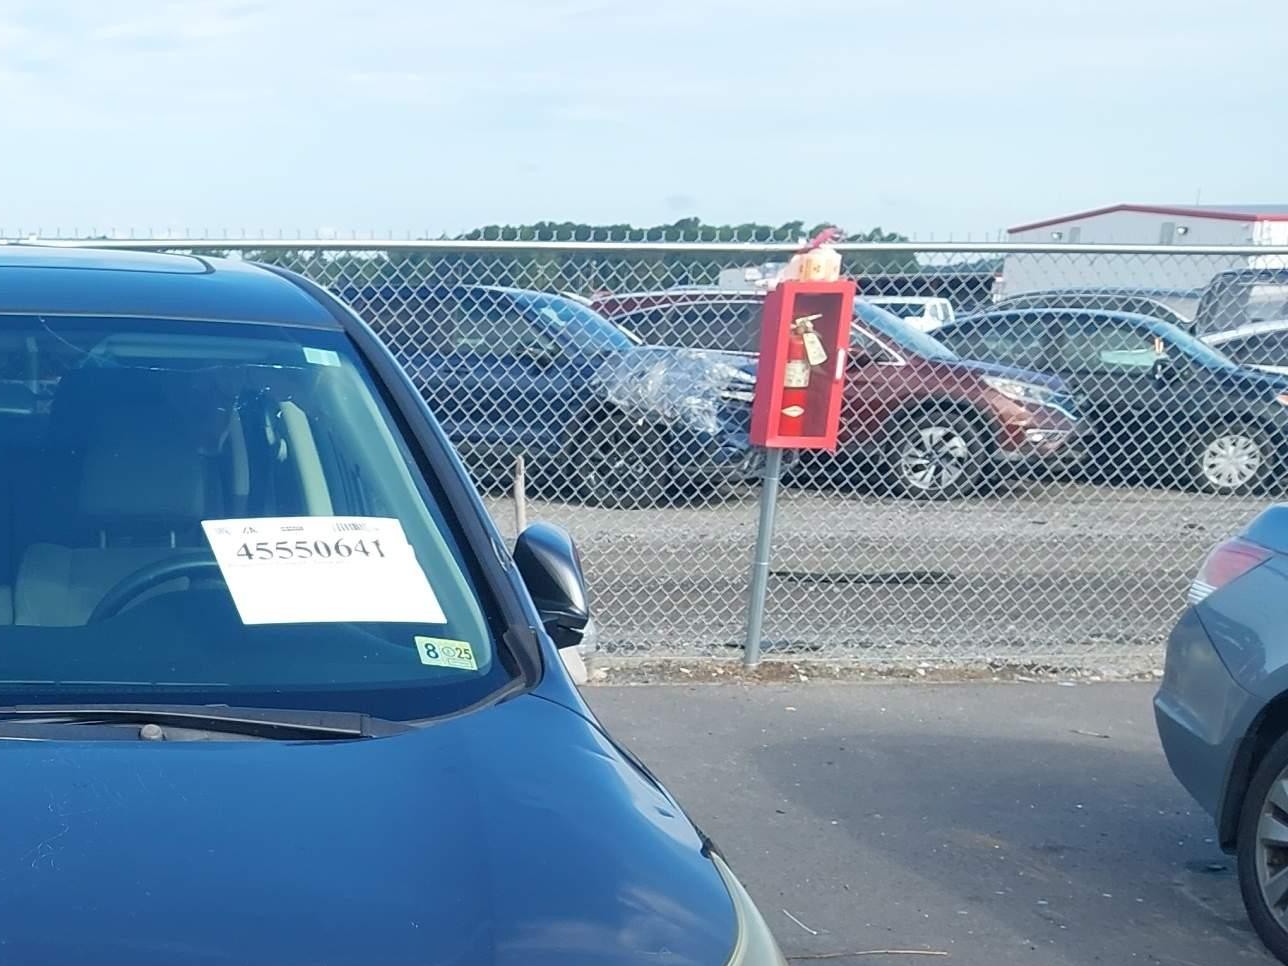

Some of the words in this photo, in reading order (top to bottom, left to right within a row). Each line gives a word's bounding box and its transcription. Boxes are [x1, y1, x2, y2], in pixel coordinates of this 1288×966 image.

[236, 538, 386, 561] 45550641
[424, 643, 439, 659] 8
[455, 647, 472, 660] 25
